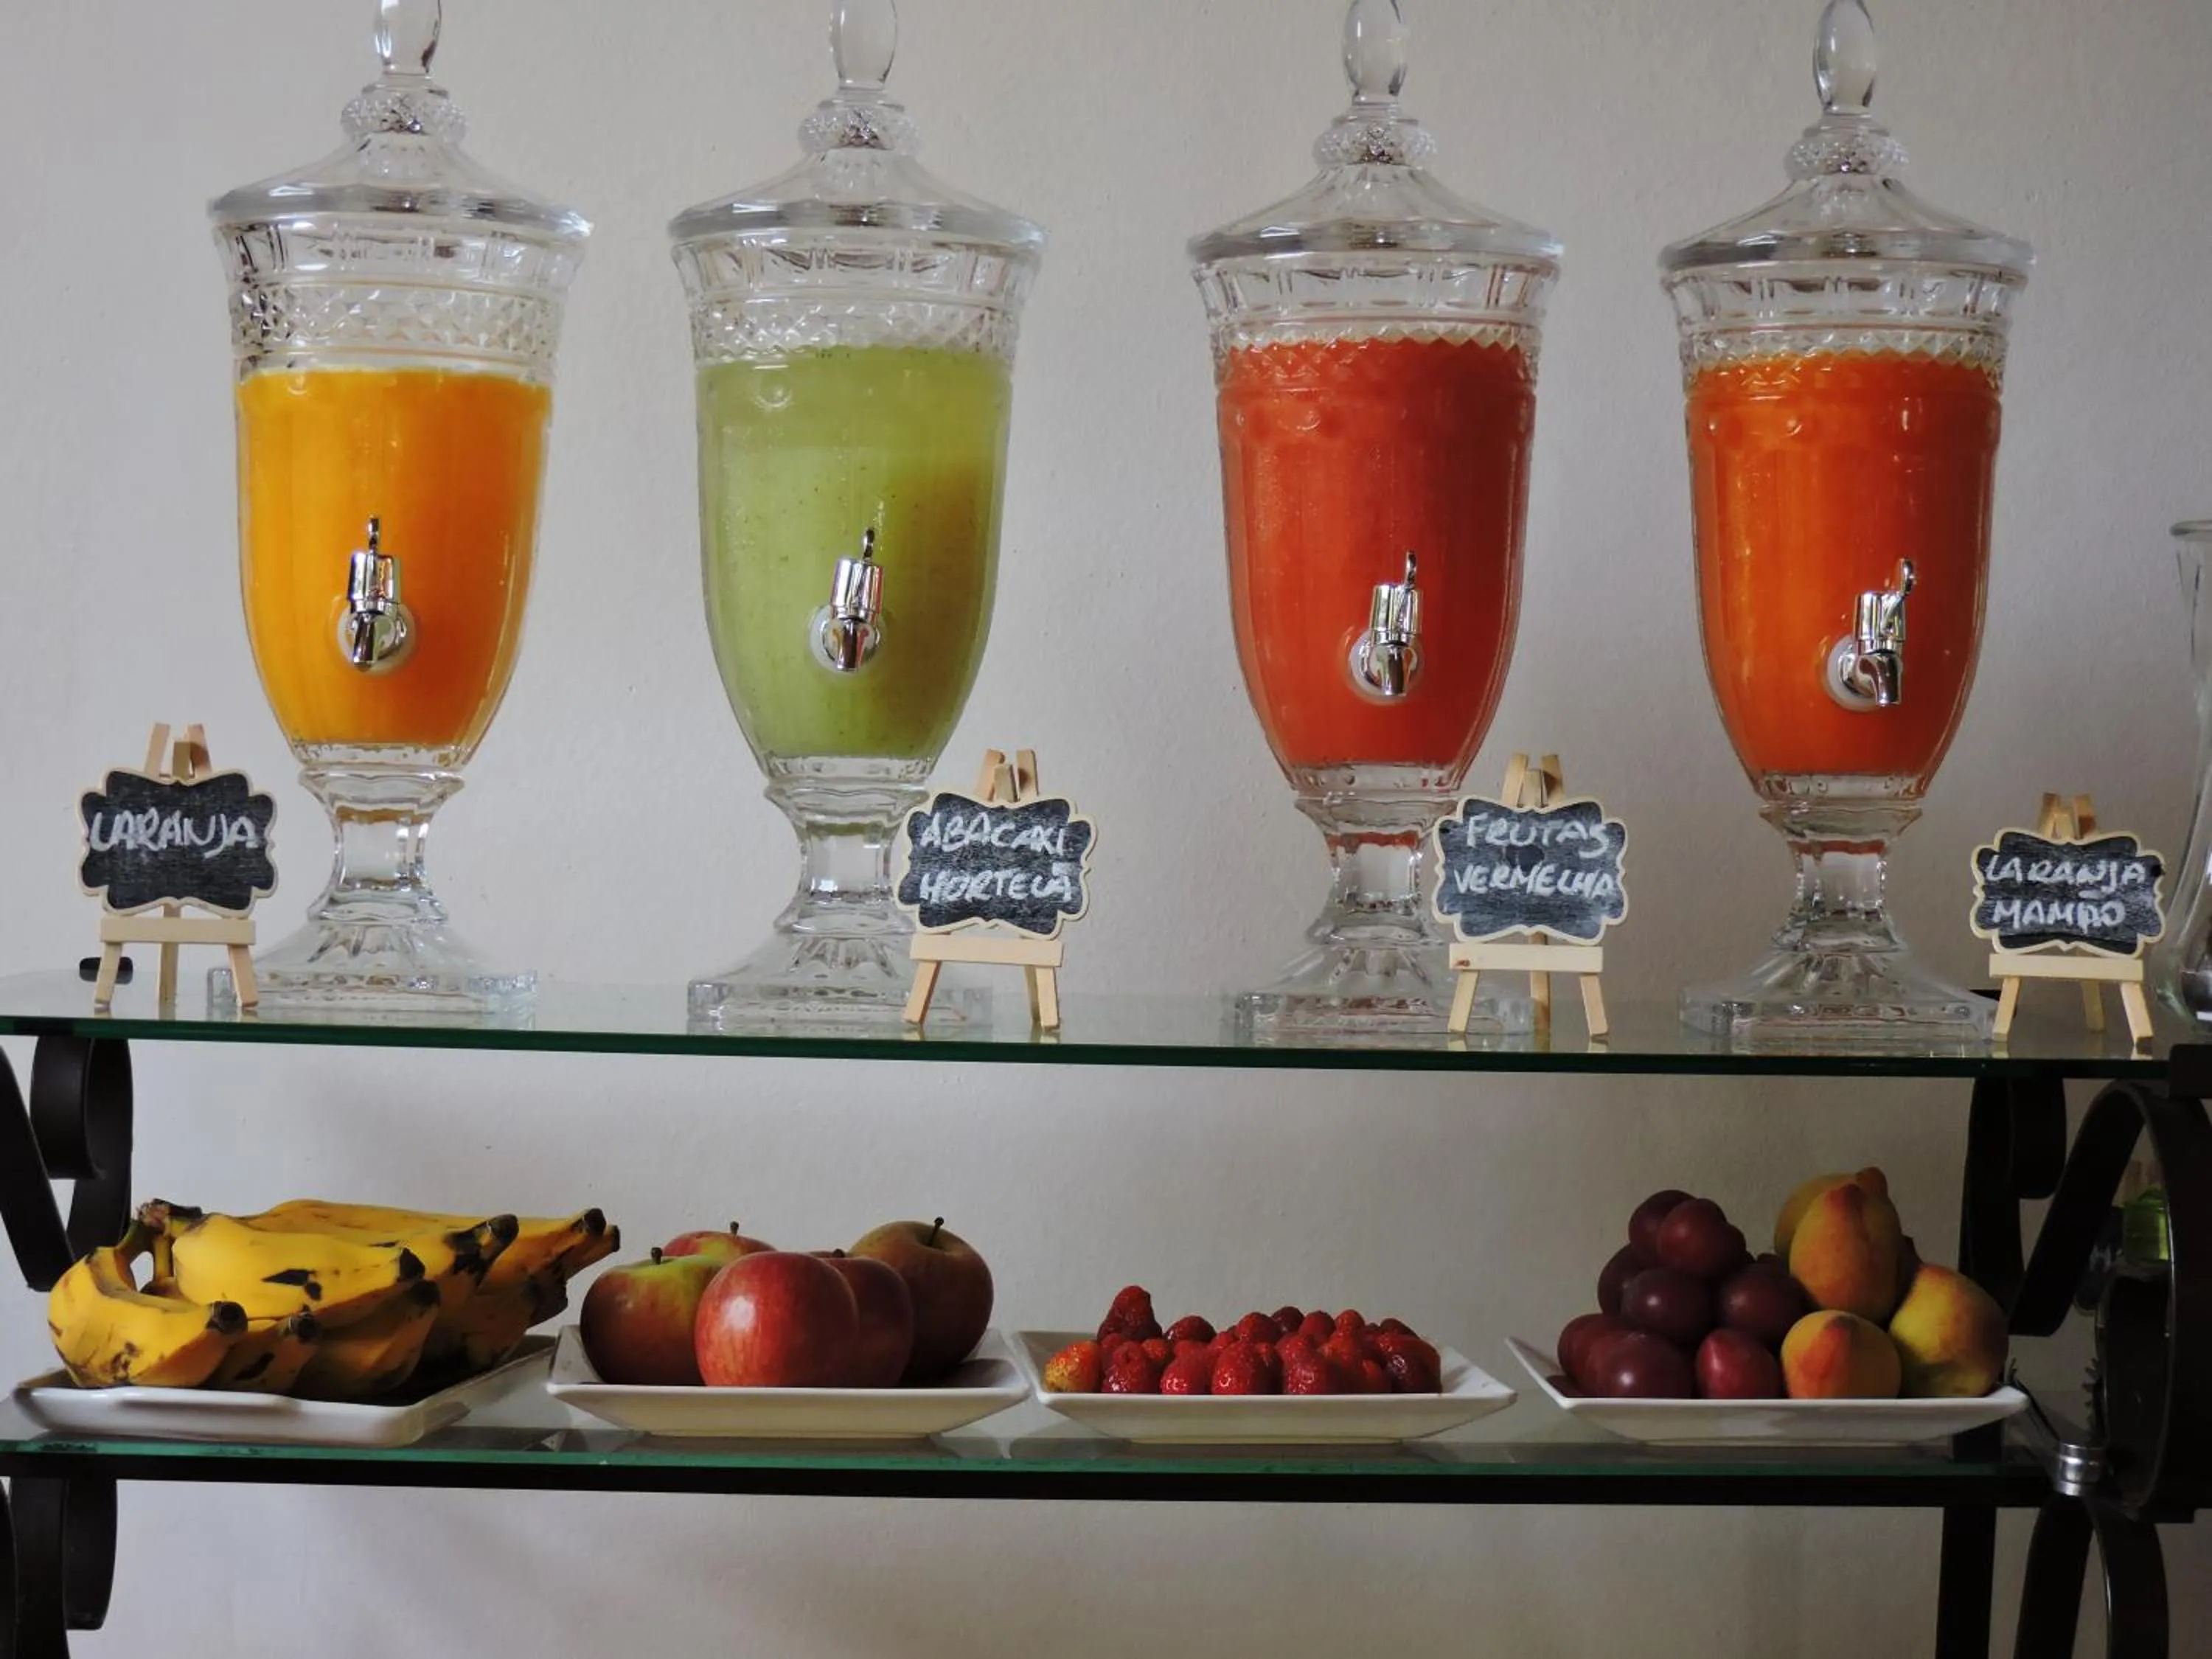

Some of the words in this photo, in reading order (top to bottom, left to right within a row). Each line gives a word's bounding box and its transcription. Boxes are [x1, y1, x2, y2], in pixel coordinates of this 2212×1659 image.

[90, 807, 258, 859] LARANJA
[1467, 812, 1610, 858] FRUTAS
[1985, 855, 2146, 895] LARANJA
